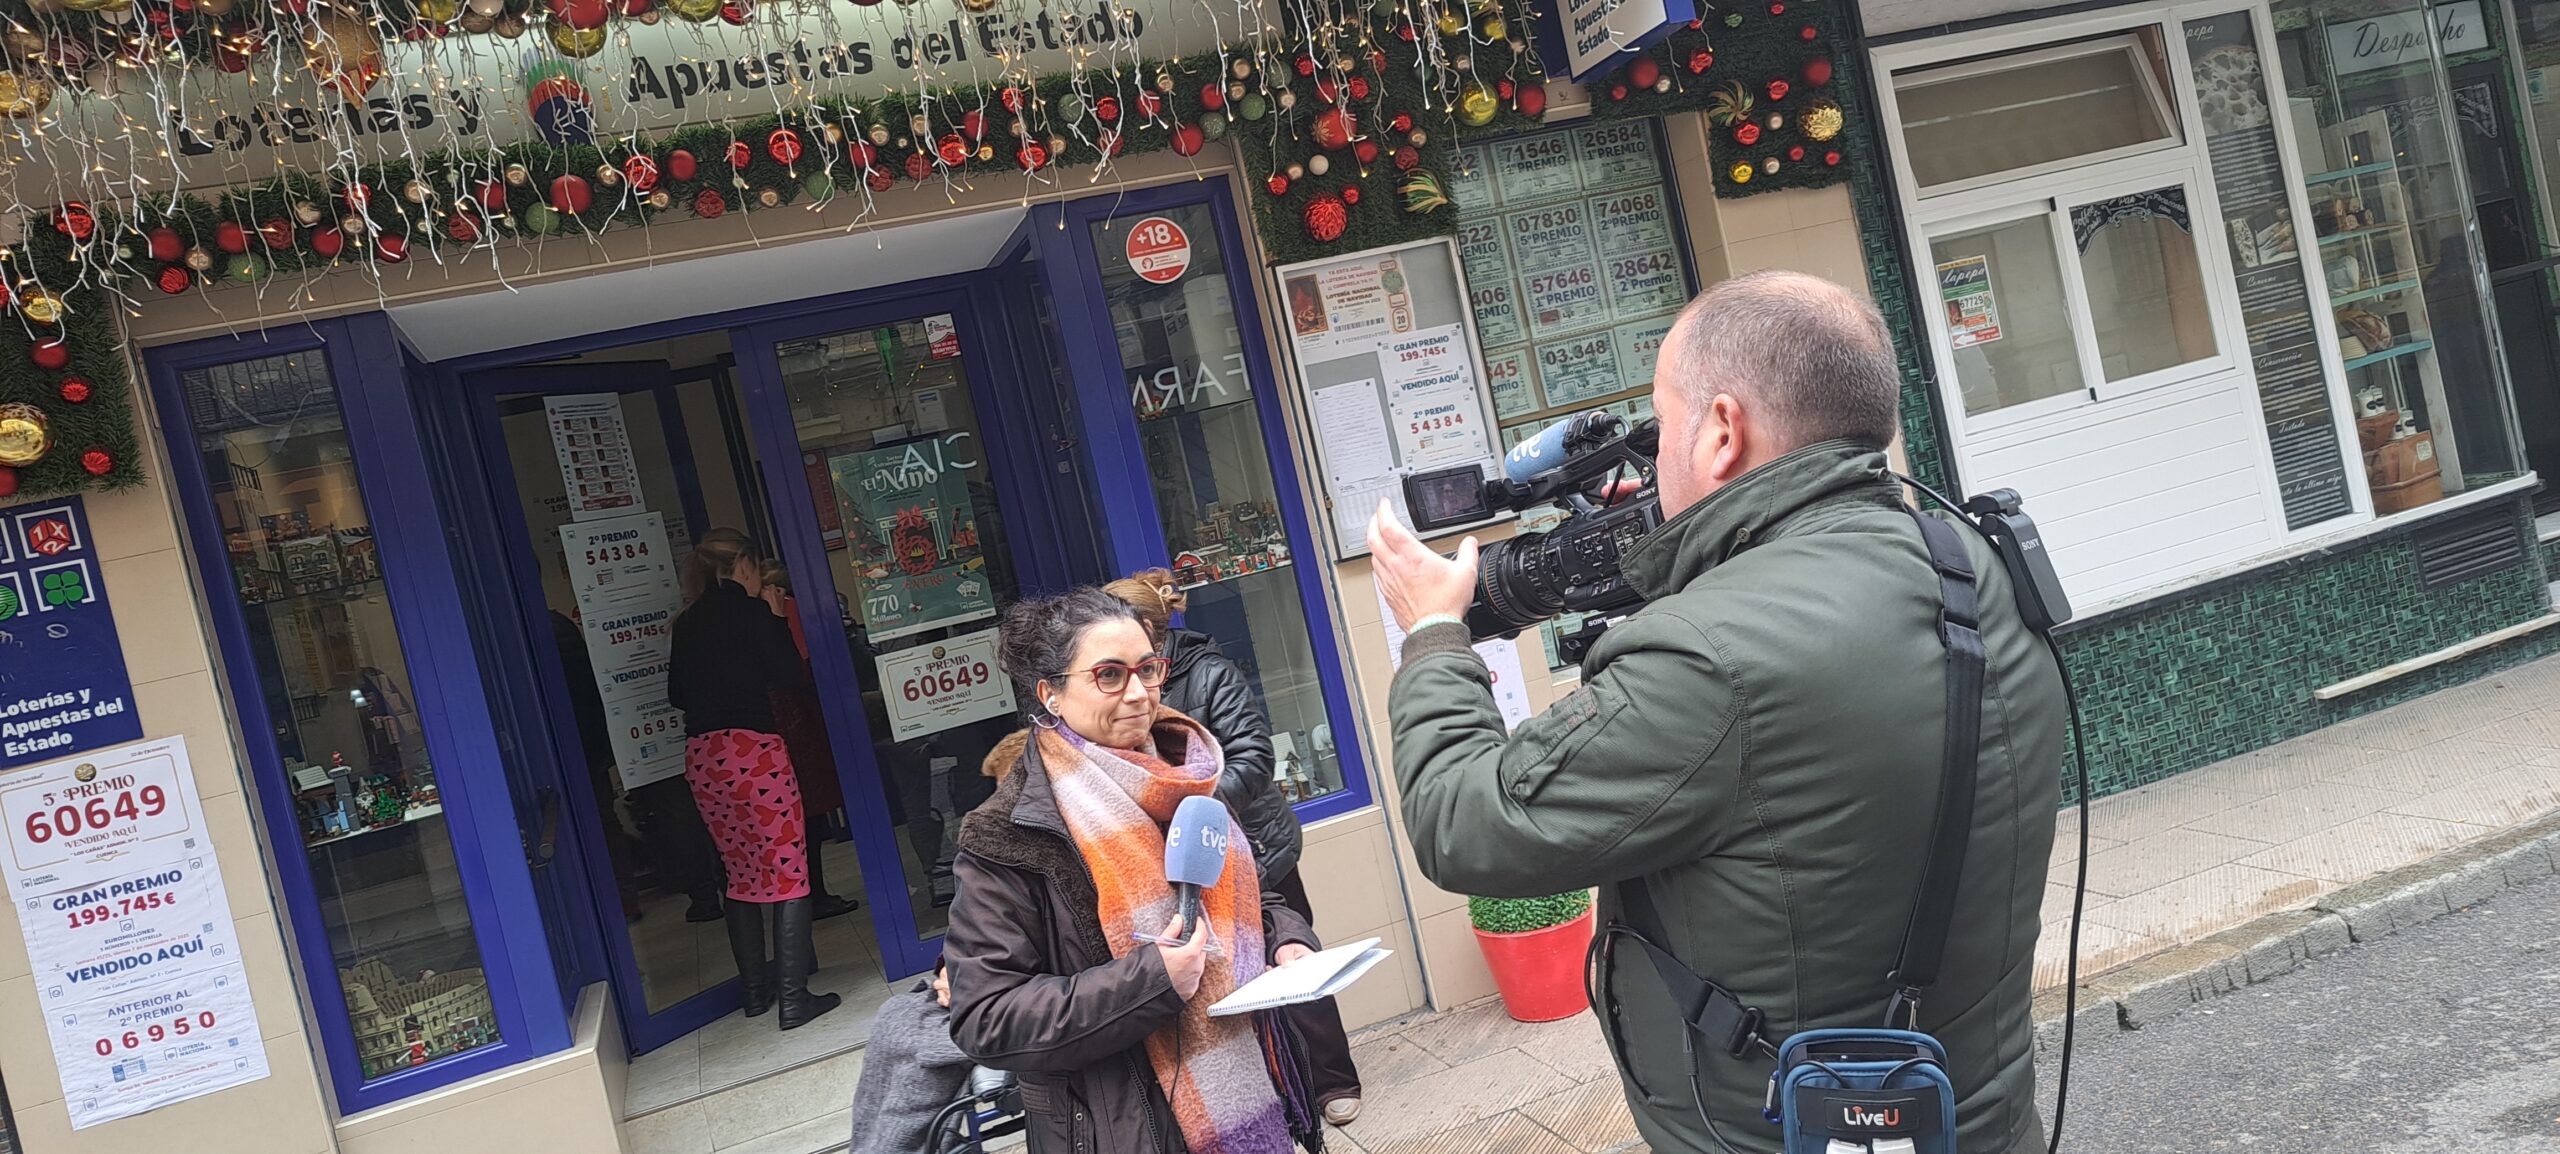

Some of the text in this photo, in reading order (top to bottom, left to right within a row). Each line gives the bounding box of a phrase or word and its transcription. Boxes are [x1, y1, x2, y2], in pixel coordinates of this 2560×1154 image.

[1577, 24, 1610, 57] Estado
[2353, 9, 2465, 61] Despaho
[626, 7, 1144, 107] Apuestas del Estado
[450, 88, 483, 136] y
[1584, 125, 1642, 148] 26584
[1503, 139, 1562, 162] 71546
[1598, 194, 1655, 218] 74068
[1517, 208, 1577, 233] 07830
[1137, 224, 1171, 246] +18
[1612, 253, 1673, 280] 28642
[1531, 268, 1591, 294] 57646
[1631, 273, 1673, 289] Premio
[1393, 335, 1450, 352] GRAN PREMIO
[1545, 340, 1607, 366] 03.348
[1400, 377, 1438, 391] VENDIDO
[1424, 404, 1456, 416] PREMIO
[1635, 487, 1657, 499] SONY
[601, 529, 639, 543] PREMIO
[2021, 537, 2040, 551] SONY
[867, 594, 900, 616] 770
[602, 610, 668, 632] GRAN PREMIO
[1587, 616, 1608, 627] SONY
[612, 665, 656, 684] VENDIDO
[926, 654, 970, 673] PREMIO
[904, 662, 989, 702] 60649
[78, 688, 91, 704] y
[927, 695, 955, 706] VENDIDO
[2, 698, 124, 739] Apuestas del
[4, 731, 73, 757] Estado
[63, 774, 135, 801] PREMIO
[25, 785, 166, 843] 60649
[64, 825, 138, 849] VENDIDO AQUÍ
[1201, 825, 1227, 856] tve
[52, 870, 183, 911] GRAN PREMIO
[104, 928, 155, 944] EUROMILLONES
[66, 935, 204, 984] VENDIDO AQUÍ
[107, 988, 193, 1018] ANTERIOR AL
[135, 1003, 184, 1024] PREMIO
[178, 1042, 205, 1053] LOTERÍA
[179, 1044, 213, 1058] NACIONAL
